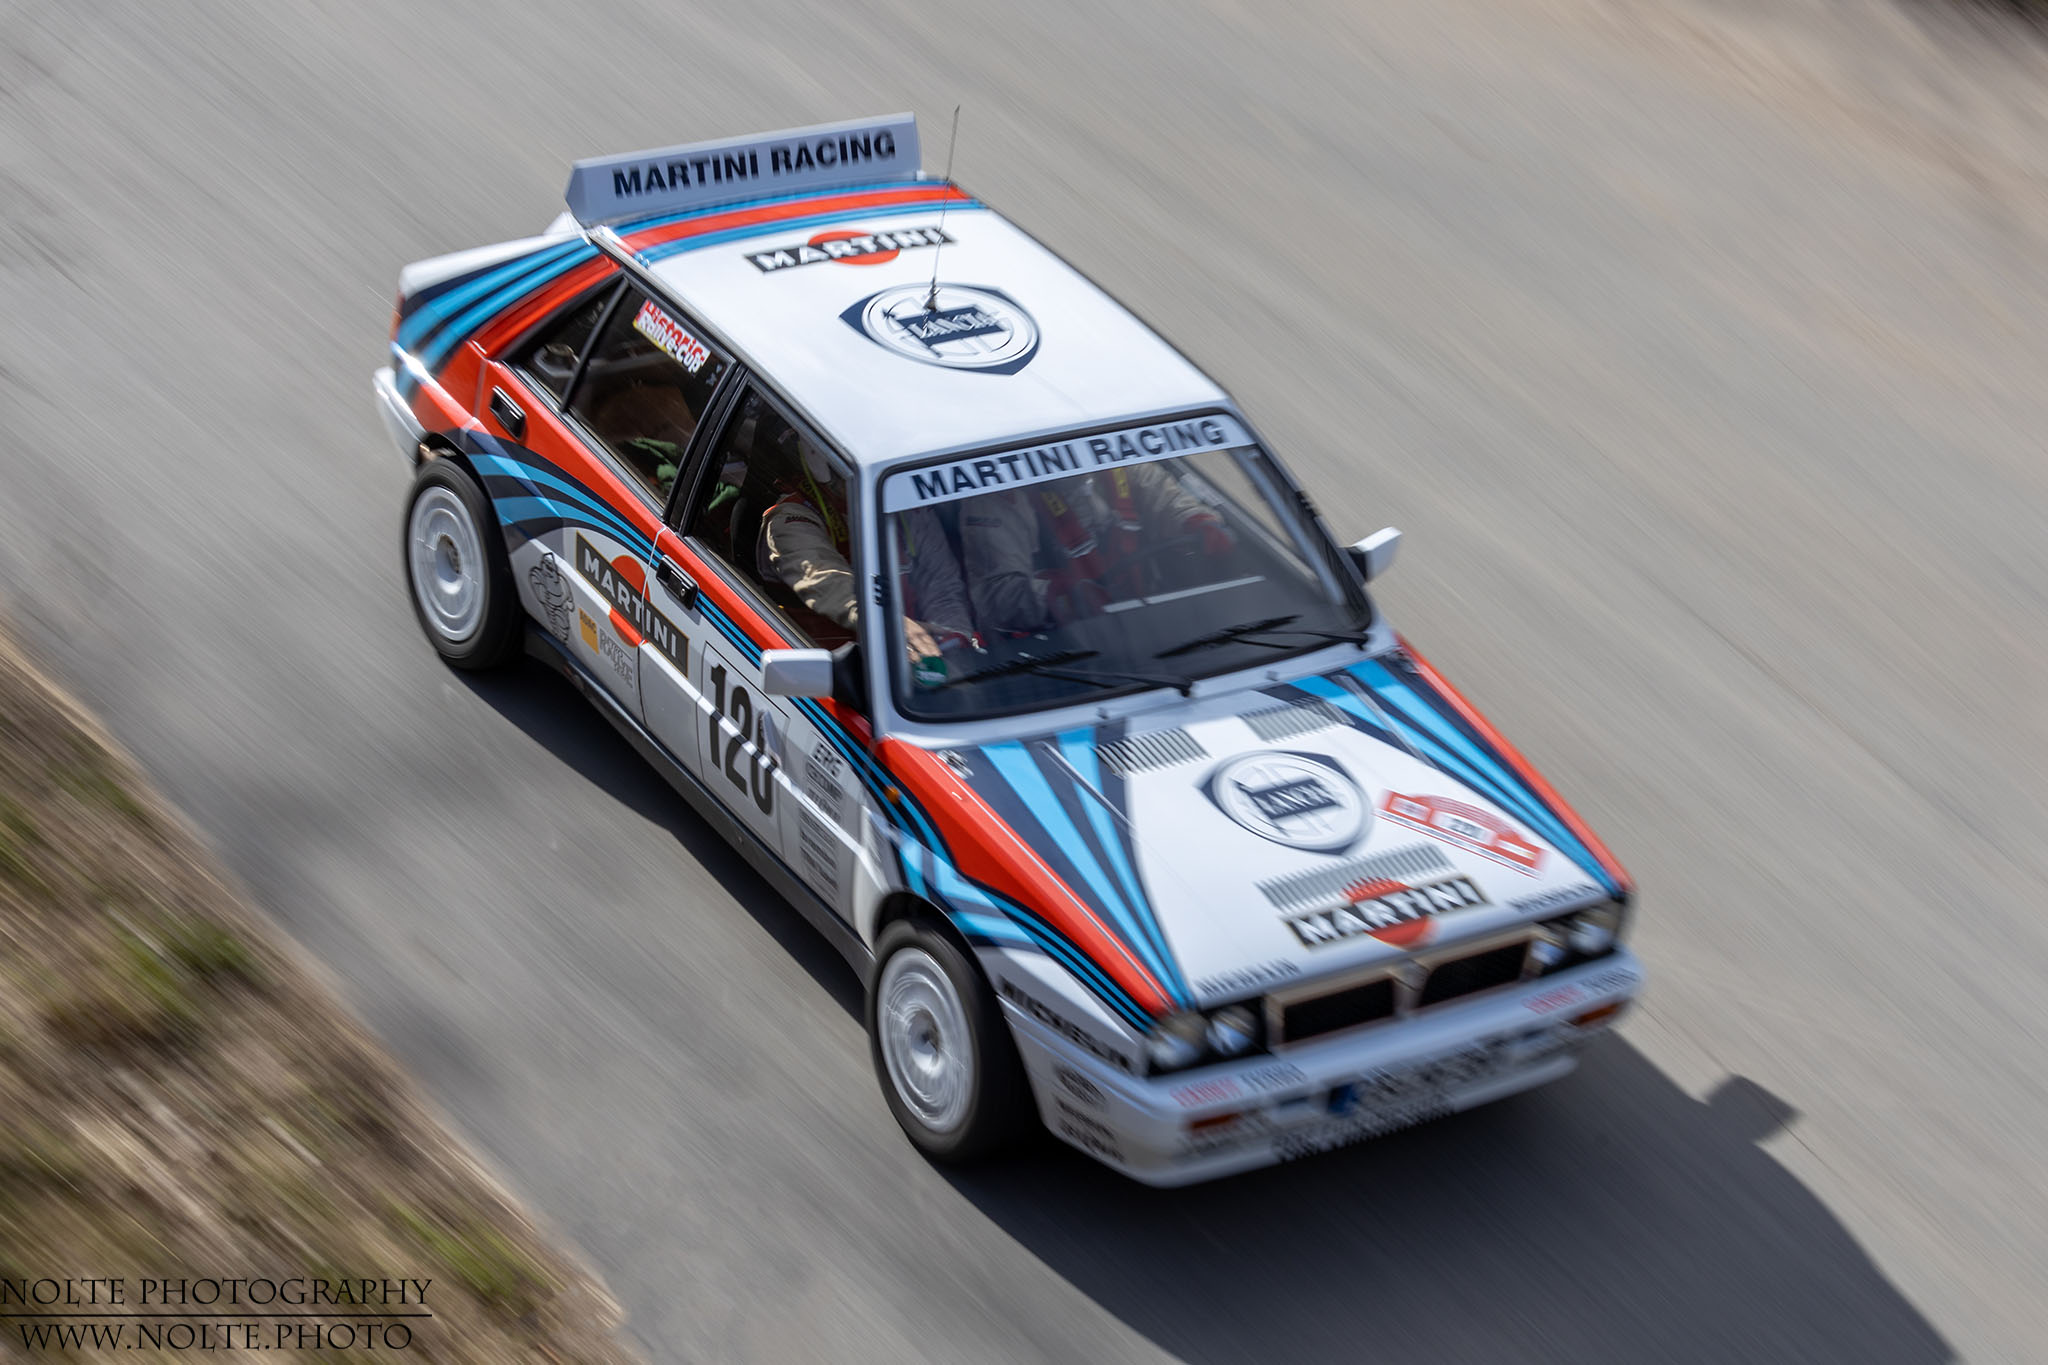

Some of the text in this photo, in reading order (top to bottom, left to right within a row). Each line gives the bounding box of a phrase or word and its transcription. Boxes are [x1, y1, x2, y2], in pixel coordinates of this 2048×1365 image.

[612, 130, 896, 198] MARTINI RACING
[757, 228, 948, 270] MARTINI
[912, 444, 1081, 500] MARTINI
[1087, 420, 1227, 463] RACING
[584, 548, 677, 658] MARTINI
[709, 663, 778, 815] 120
[1300, 878, 1482, 945] MARTINI
